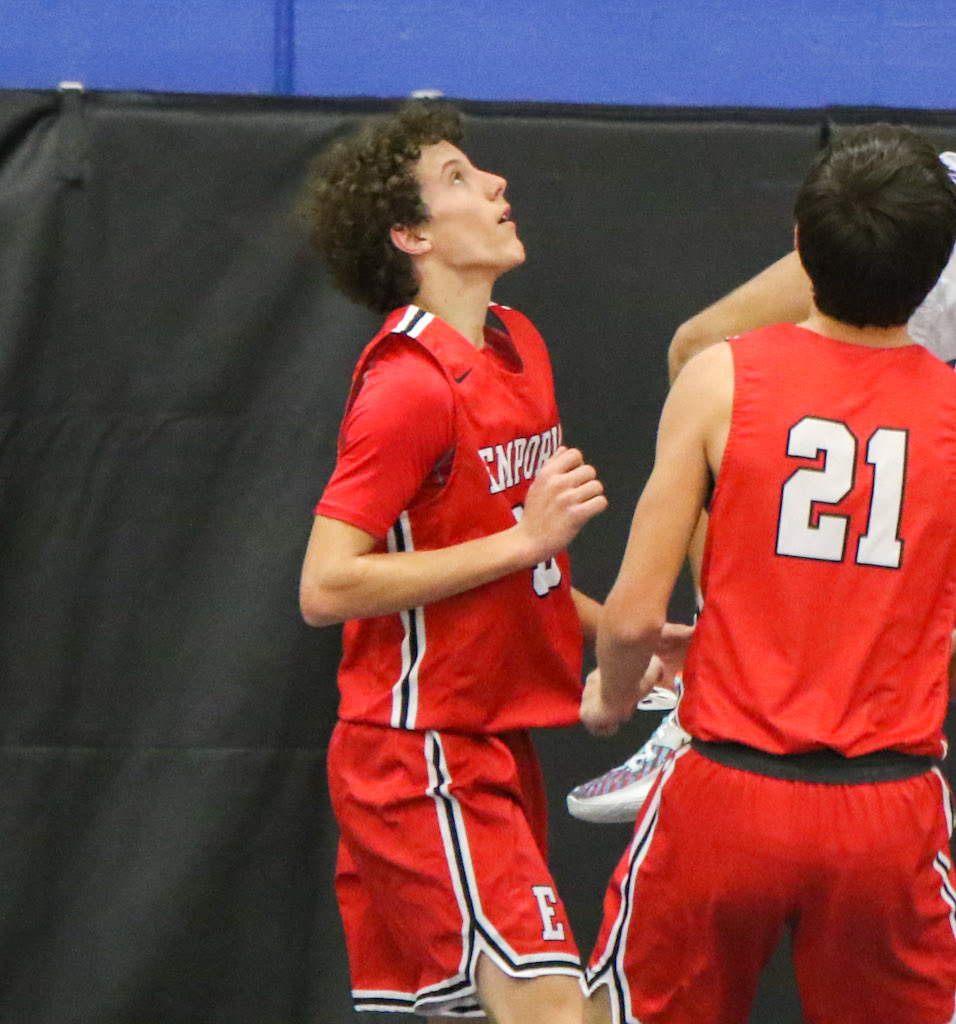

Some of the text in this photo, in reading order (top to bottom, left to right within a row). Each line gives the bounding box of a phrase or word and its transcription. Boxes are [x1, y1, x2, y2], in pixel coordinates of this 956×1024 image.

[478, 423, 562, 495] EMPORI
[775, 414, 909, 569] 21
[531, 884, 565, 942] E
